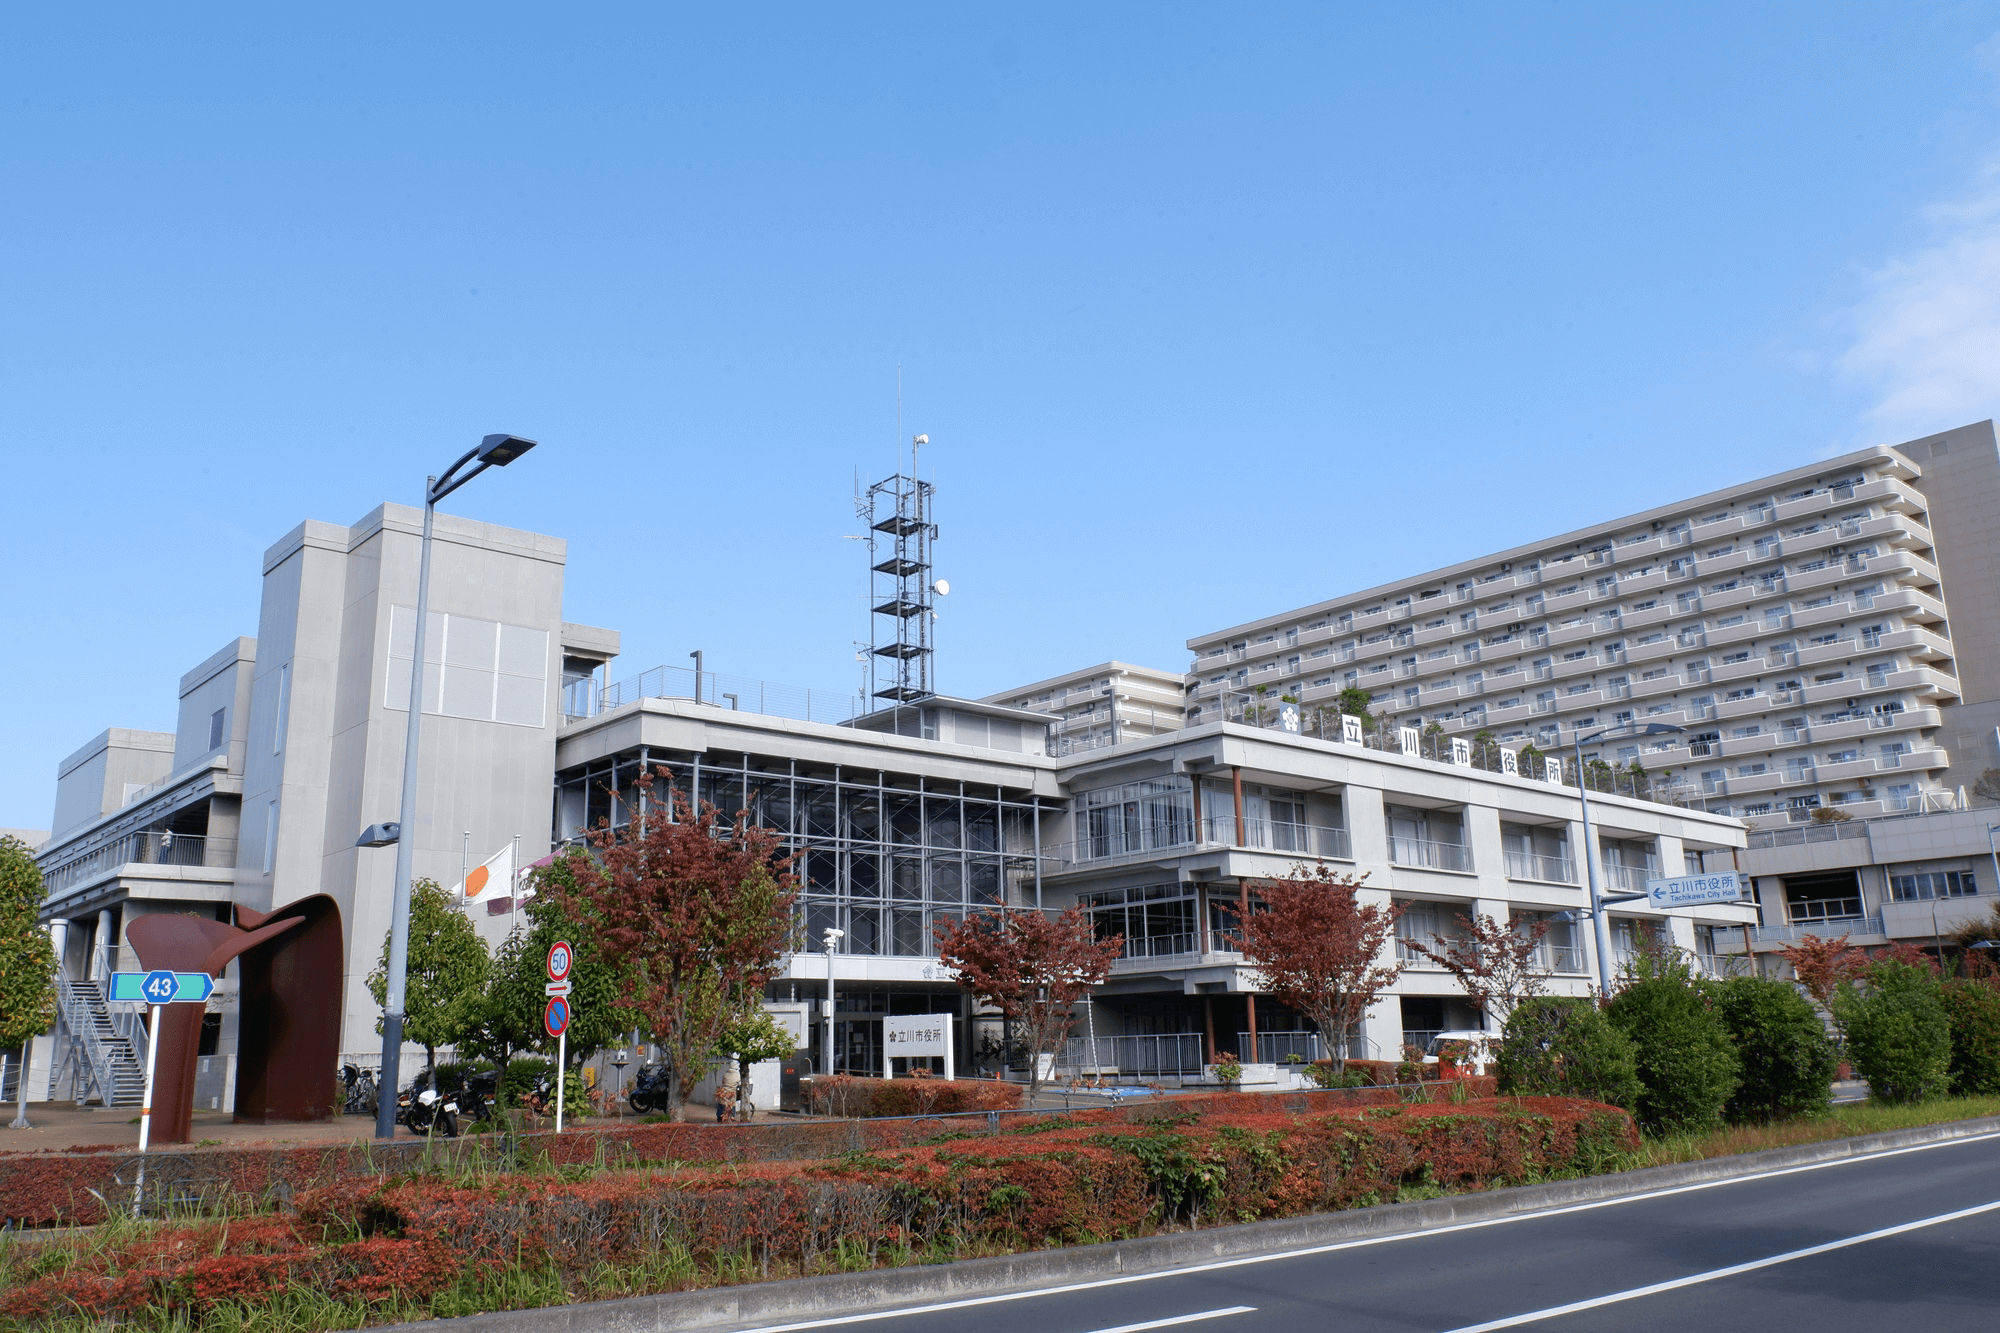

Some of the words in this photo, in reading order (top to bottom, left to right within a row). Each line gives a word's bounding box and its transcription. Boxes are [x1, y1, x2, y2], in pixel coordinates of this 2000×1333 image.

[1345, 720, 1559, 781] 立川市役所
[1669, 876, 1733, 894] 立川市役所
[1670, 893, 1705, 902] Tachikawa
[1707, 890, 1720, 899] City
[552, 953, 566, 970] 50
[148, 978, 172, 997] 43
[898, 1028, 941, 1043] 立川市役所
